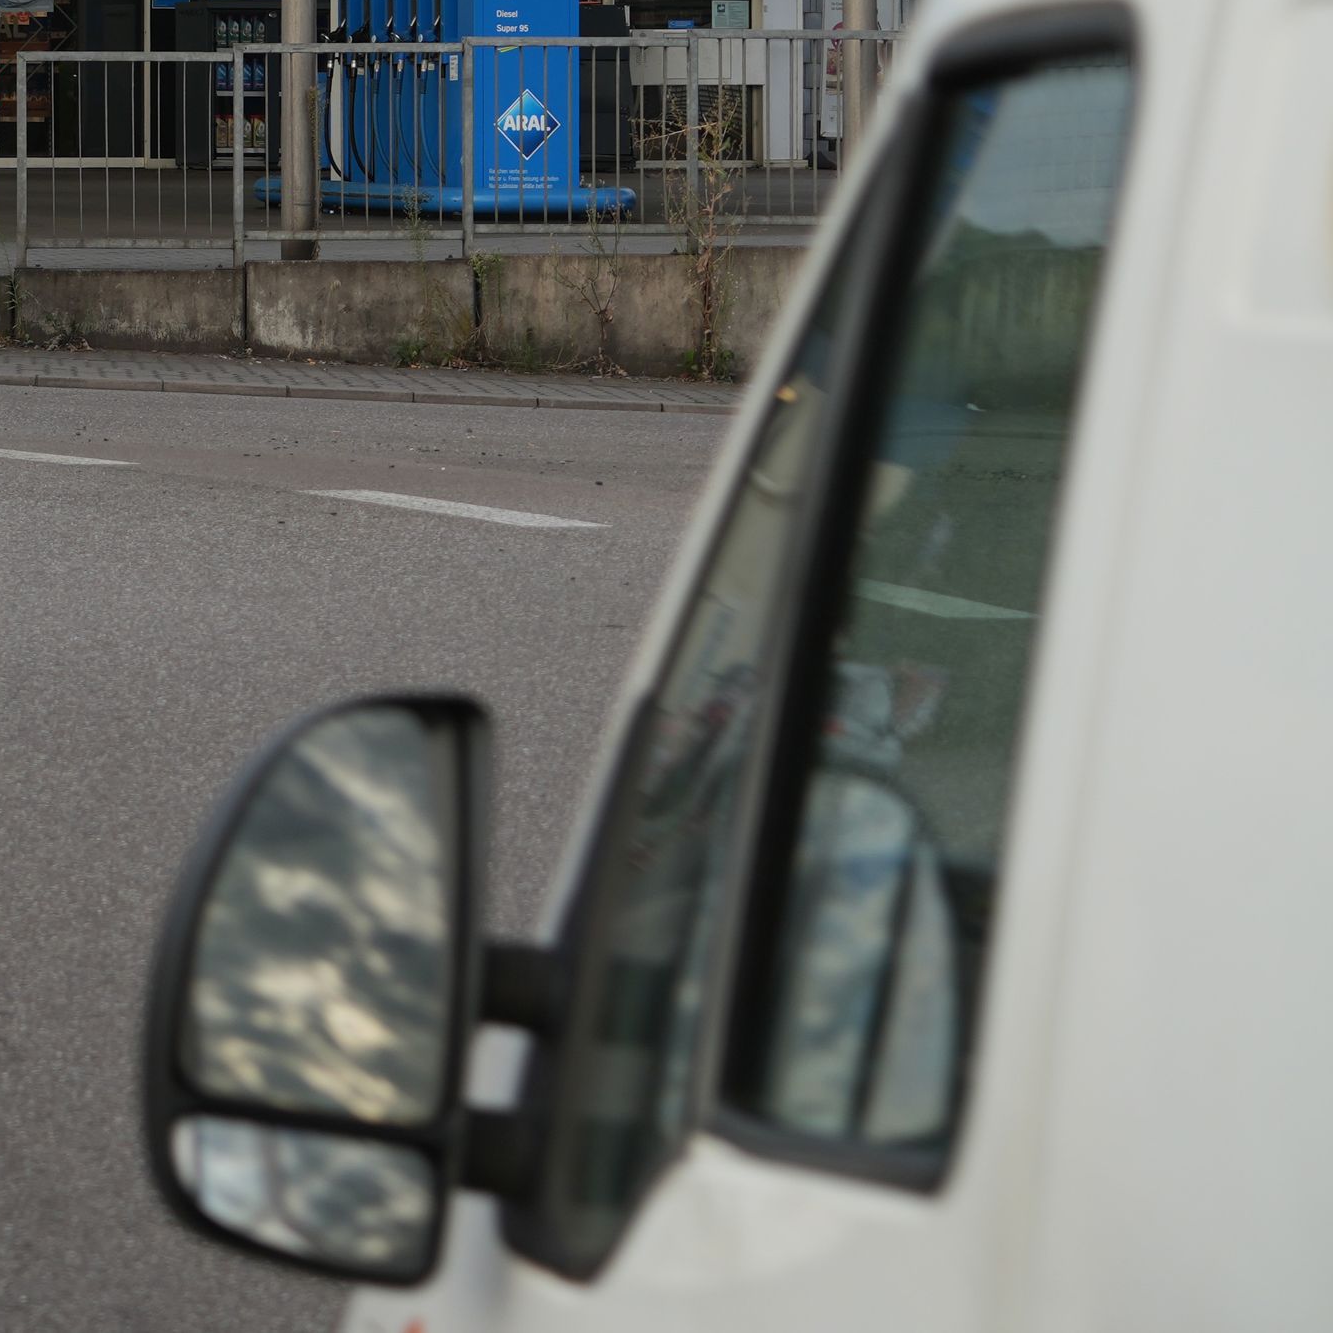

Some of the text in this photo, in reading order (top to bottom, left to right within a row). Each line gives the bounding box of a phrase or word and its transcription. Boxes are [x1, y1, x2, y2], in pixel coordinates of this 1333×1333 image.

[496, 10, 518, 18] Diesel
[496, 24, 529, 33] Super 95
[503, 115, 551, 132] ARAL
